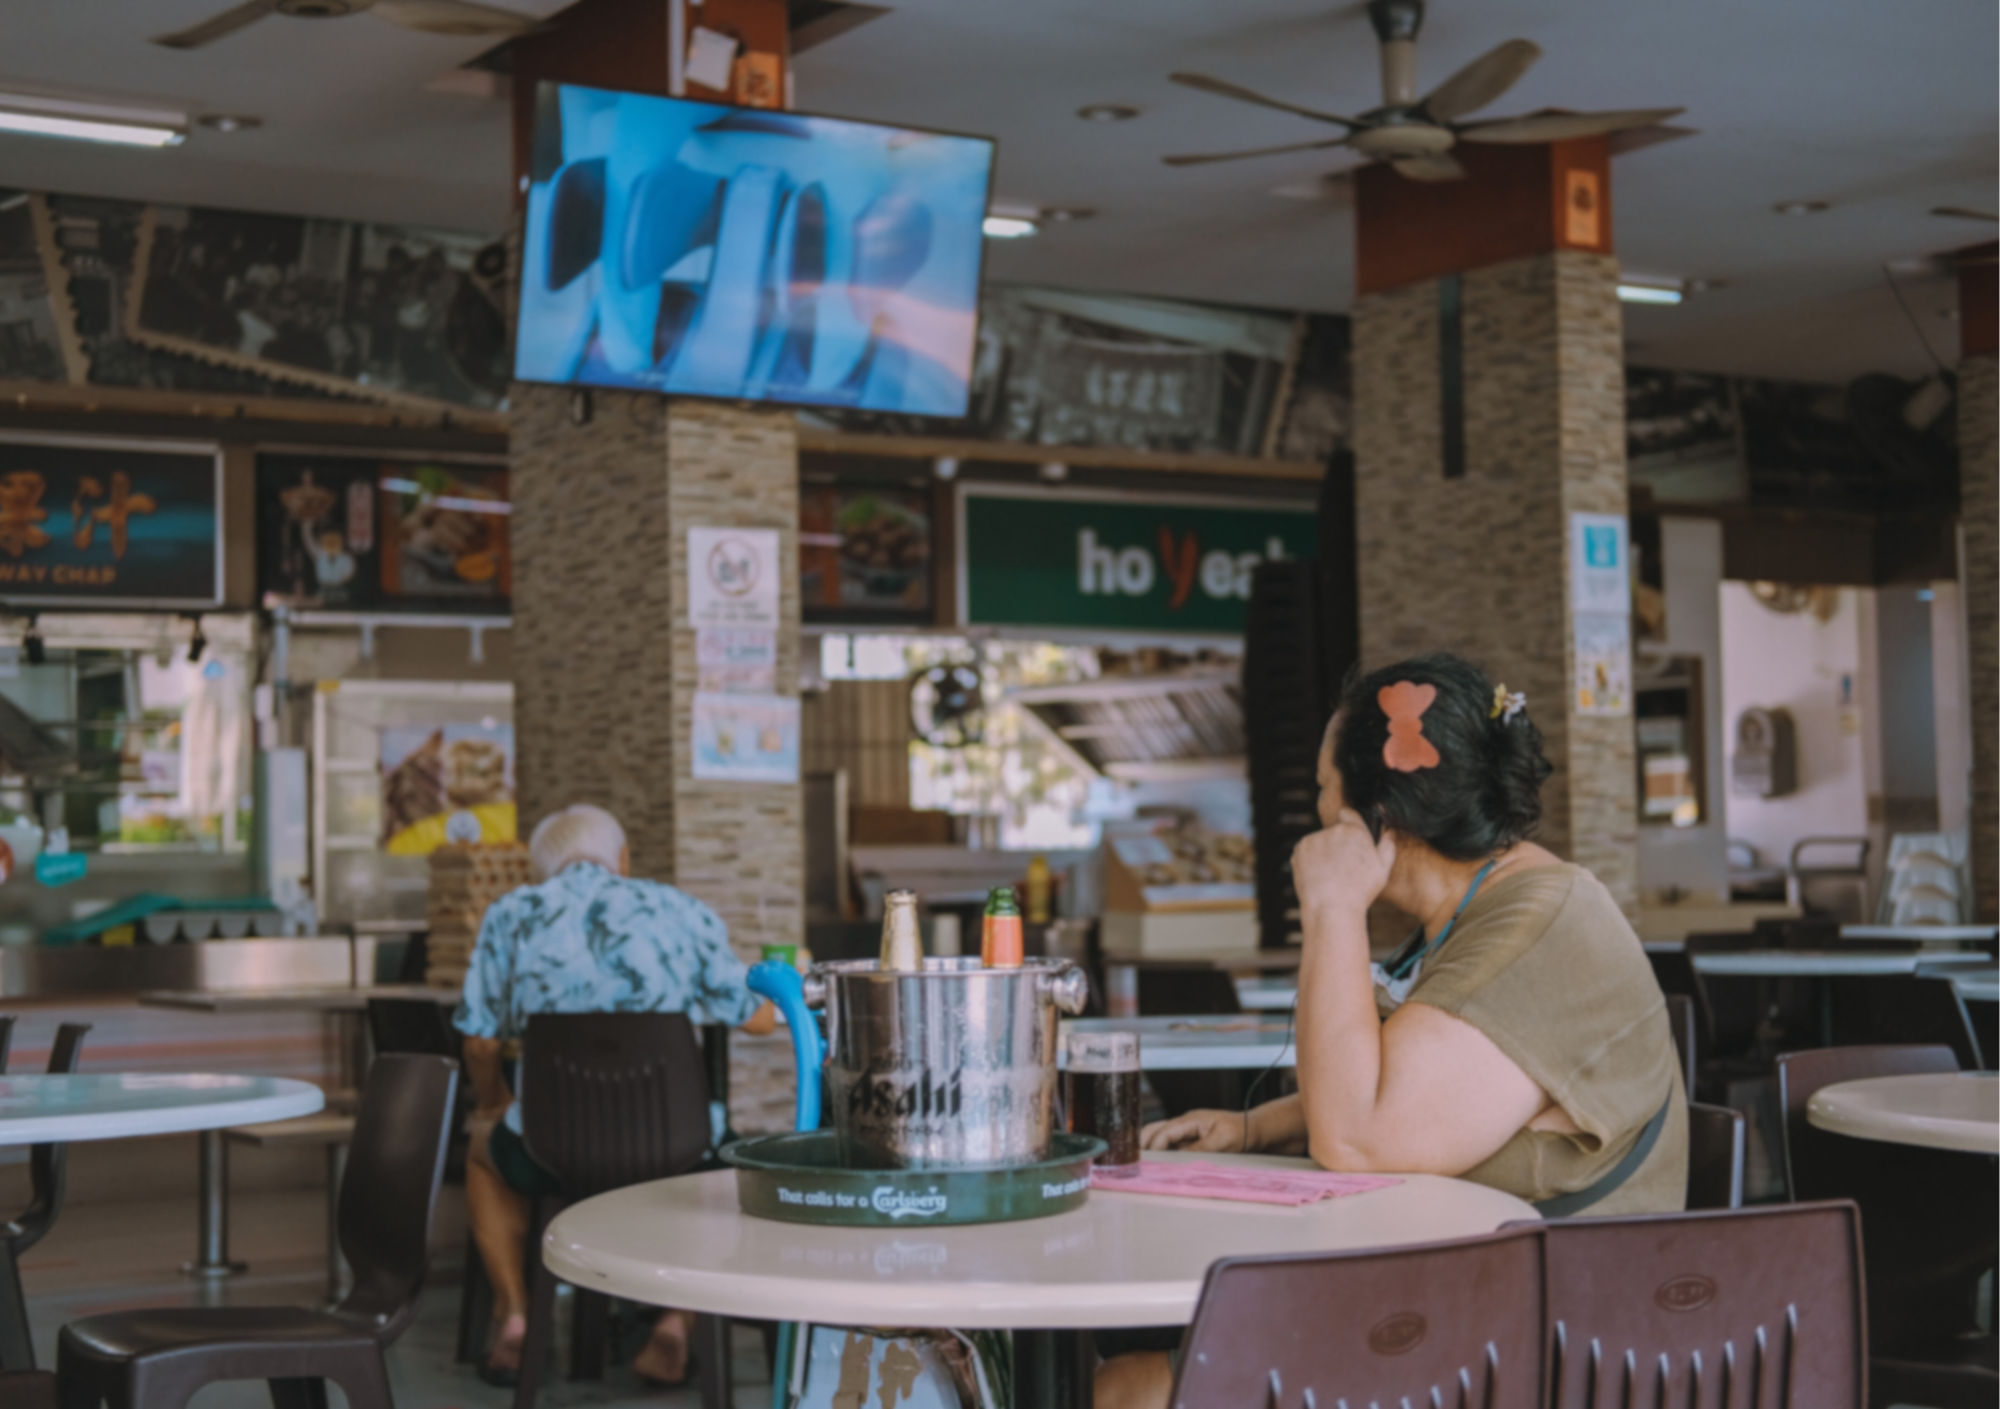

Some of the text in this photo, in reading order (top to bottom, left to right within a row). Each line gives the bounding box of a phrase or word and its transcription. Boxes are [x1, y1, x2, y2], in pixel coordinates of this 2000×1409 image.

[52, 564, 117, 584] CHAP
[851, 1067, 962, 1118] Asahi
[777, 1186, 947, 1220] That calls for a Carlsberg
[1042, 1182, 1063, 1199] That
